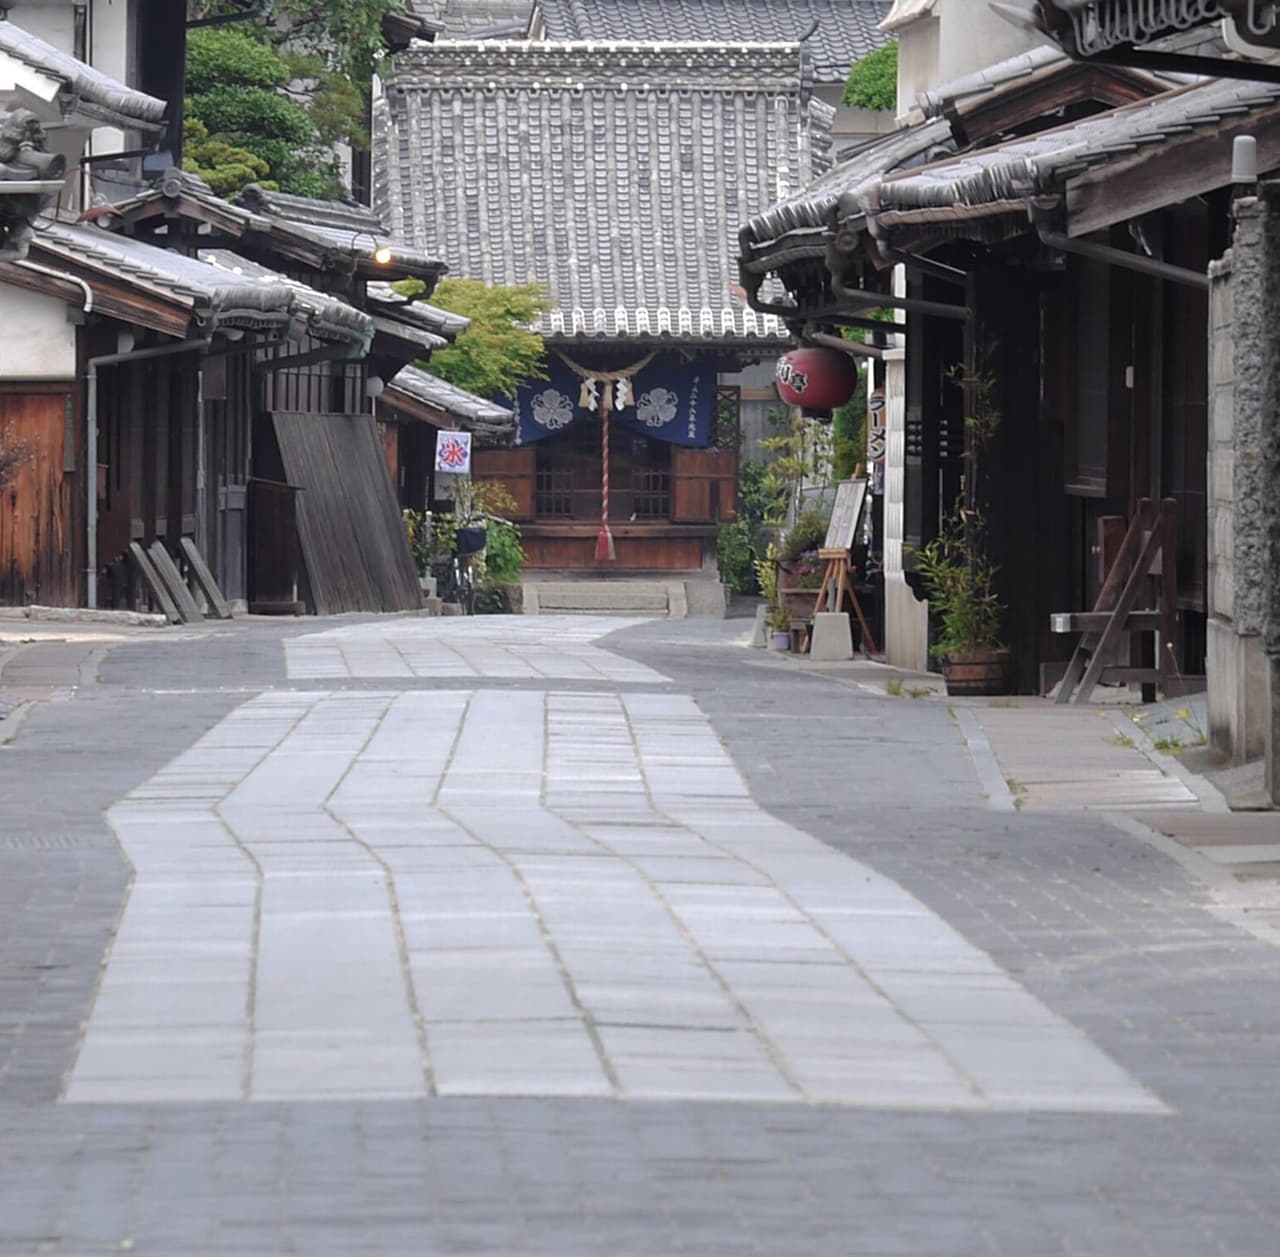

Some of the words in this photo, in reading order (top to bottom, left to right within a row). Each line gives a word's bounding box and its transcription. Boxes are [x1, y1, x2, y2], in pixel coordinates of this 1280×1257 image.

[869, 395, 886, 460] ラーメン
[442, 440, 466, 466] 氷
